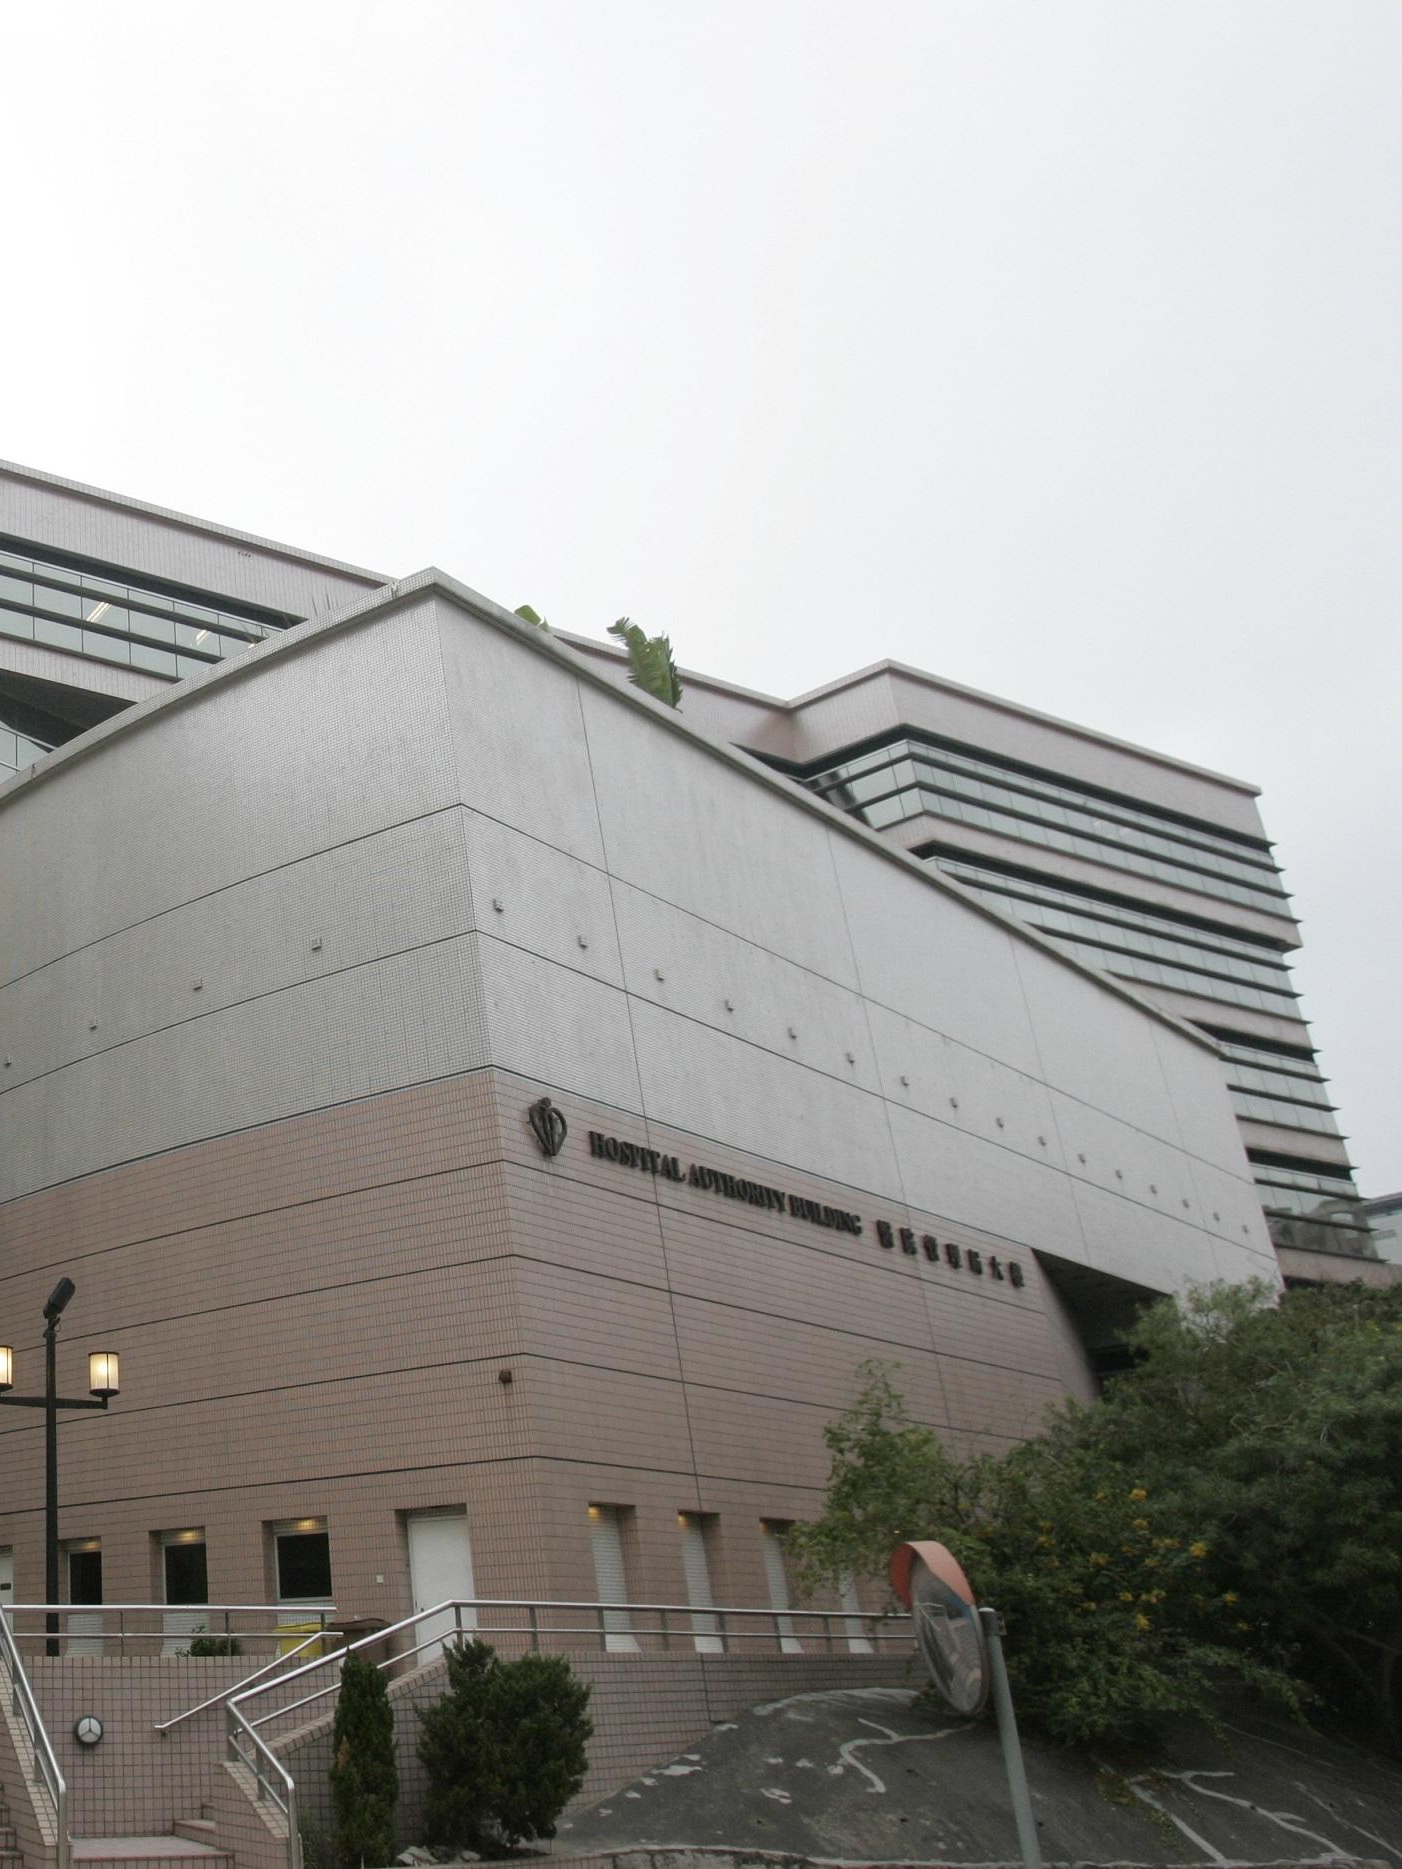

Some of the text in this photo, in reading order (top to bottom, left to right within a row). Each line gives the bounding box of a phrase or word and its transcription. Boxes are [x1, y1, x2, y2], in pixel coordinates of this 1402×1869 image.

[587, 1130, 863, 1237] HOSPITAL AUTHORITY BUILDING
